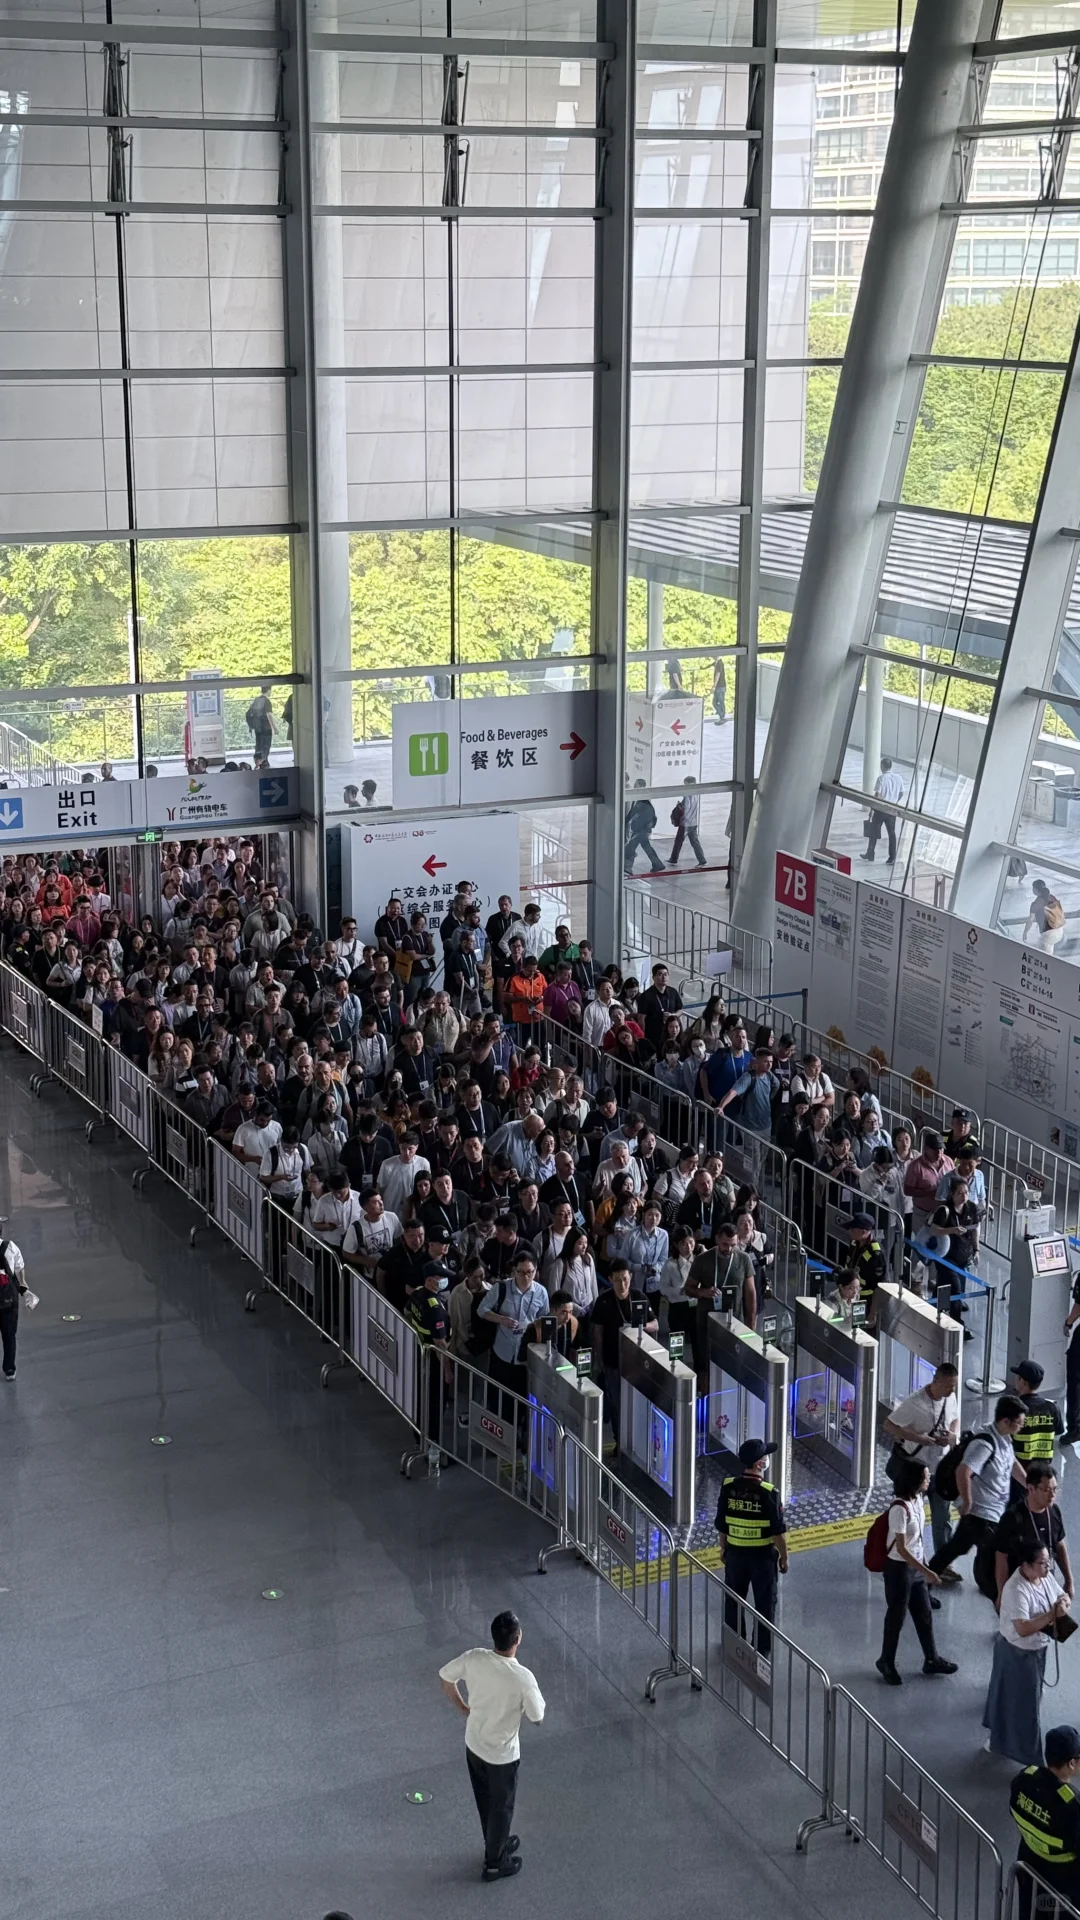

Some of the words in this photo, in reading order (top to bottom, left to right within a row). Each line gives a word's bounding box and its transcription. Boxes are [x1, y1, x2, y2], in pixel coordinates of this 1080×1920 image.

[460, 730, 485, 743] Food
[487, 730, 495, 742] &
[498, 728, 548, 742] Beverages
[471, 747, 538, 771] 餐饮区
[59, 790, 96, 809] 出口
[180, 804, 228, 815] 广州有轨电车
[58, 812, 98, 828] Exit
[390, 881, 478, 899] 广交会办证心
[783, 866, 807, 901] 7B
[777, 929, 810, 953] 安检验证点
[1027, 1174, 1044, 1189] CFTC
[482, 1418, 503, 1437] CFTC
[728, 1498, 762, 1513] 海保卫士
[608, 1518, 625, 1542] CFTC
[1016, 1791, 1051, 1826] 海保卫士
